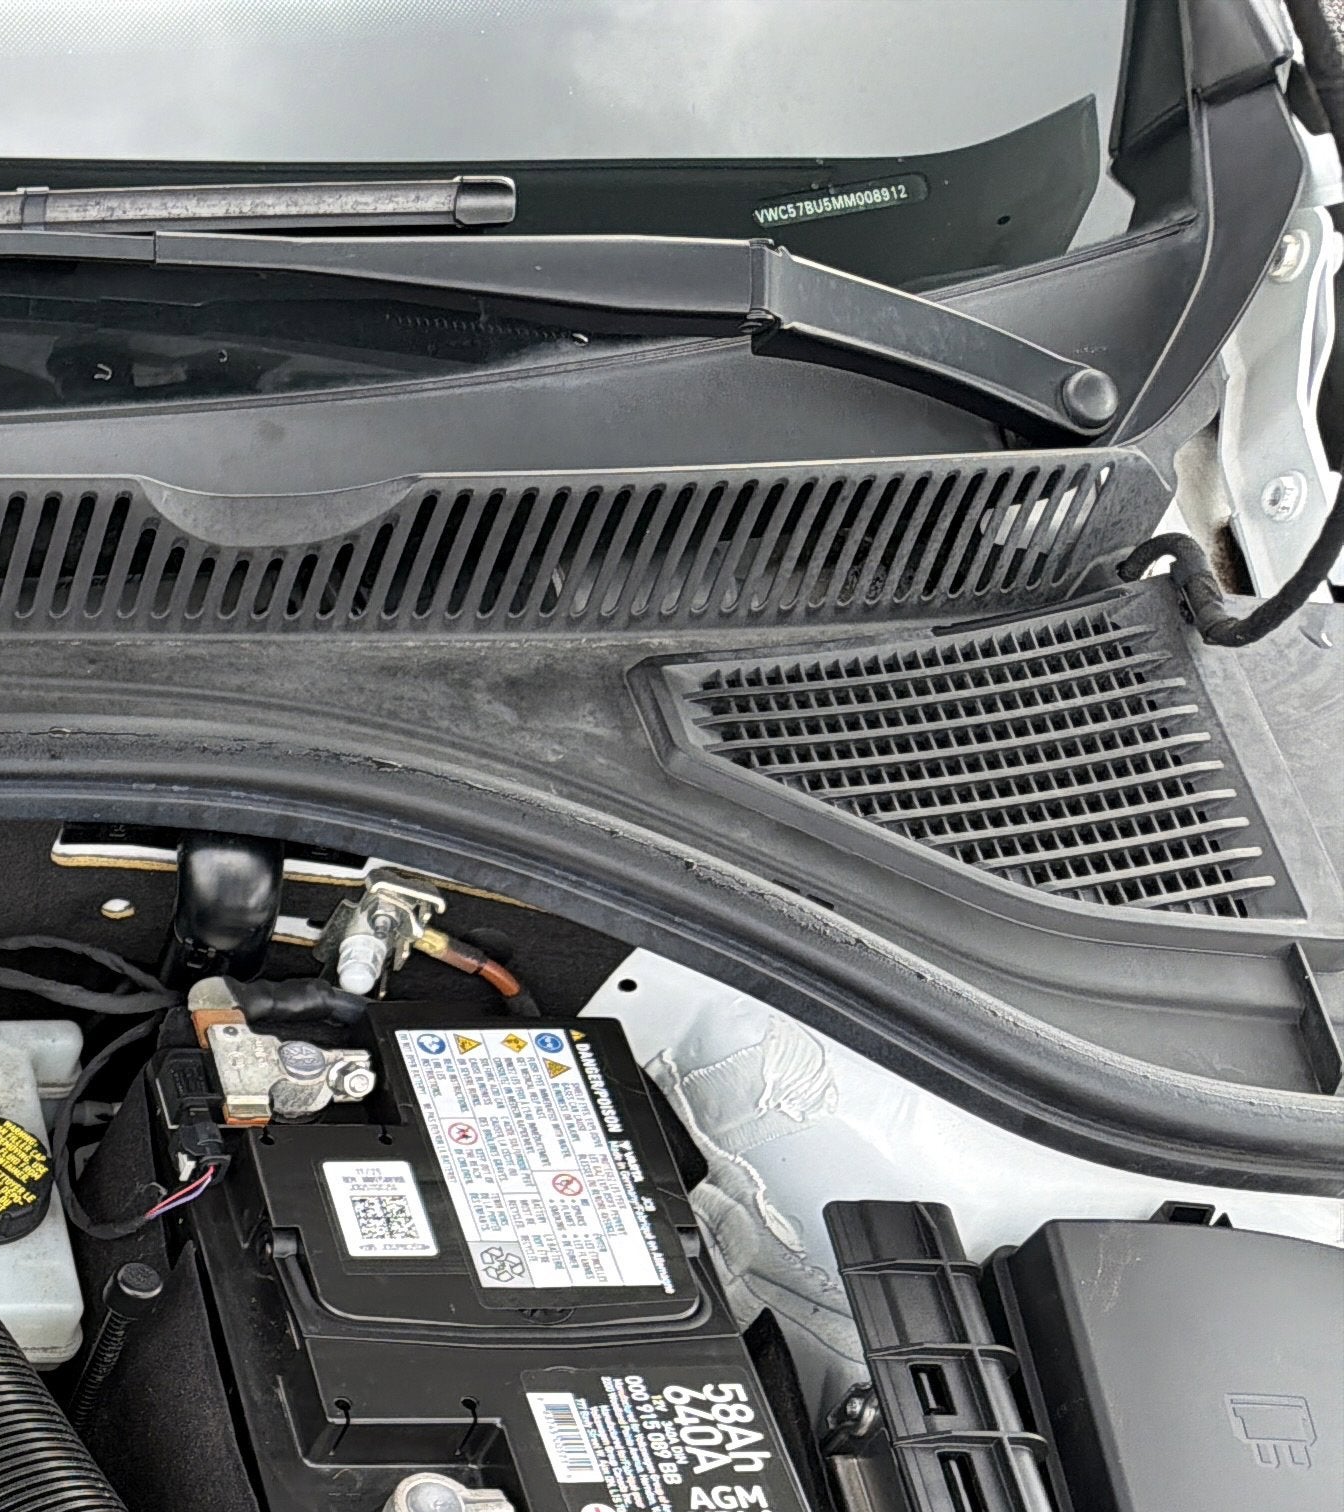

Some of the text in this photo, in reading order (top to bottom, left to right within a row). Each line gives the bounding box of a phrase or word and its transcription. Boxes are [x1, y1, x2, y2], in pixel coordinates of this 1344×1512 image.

[574, 1043, 623, 1132] DANGER/POISON
[4, 1120, 38, 1147] WARNING:
[5, 1132, 32, 1152] FILLER
[29, 1150, 46, 1161] CAP
[623, 1375, 683, 1484] 000 915 089 BB
[650, 1392, 668, 1414] 12V
[670, 1443, 688, 1466] DIN
[663, 1385, 737, 1474] 640A
[702, 1383, 772, 1472] 58Ah
[690, 1485, 769, 1510] AGM
